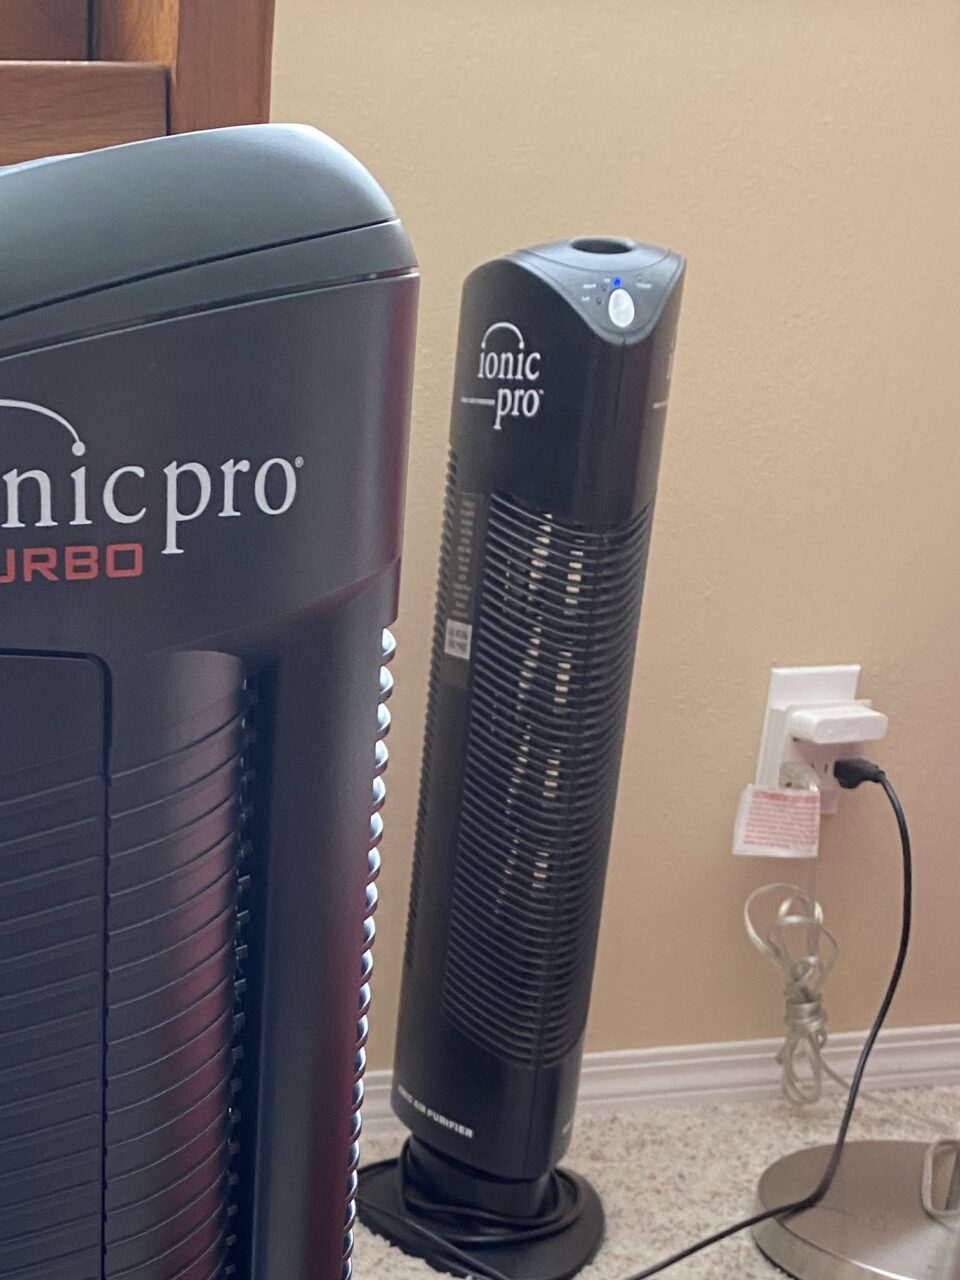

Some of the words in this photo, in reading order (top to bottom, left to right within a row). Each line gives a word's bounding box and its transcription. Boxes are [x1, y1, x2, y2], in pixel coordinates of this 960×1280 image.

[477, 341, 541, 380] ionic
[493, 388, 540, 430] pro
[427, 1108, 473, 1138] PURIFIER
